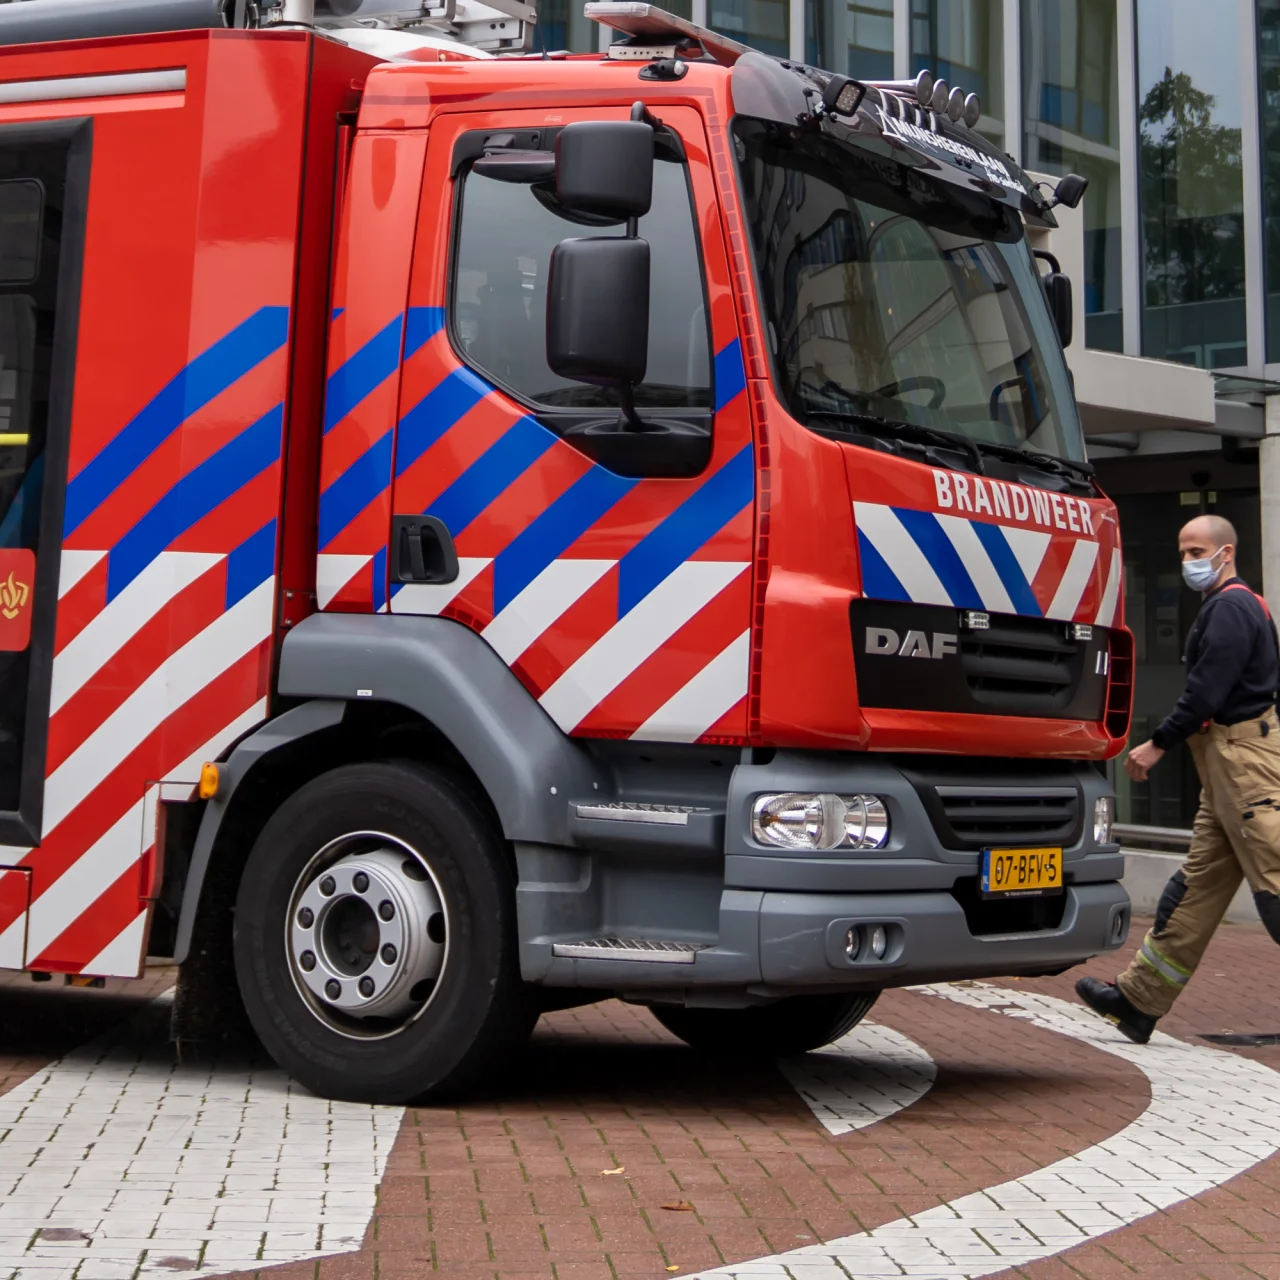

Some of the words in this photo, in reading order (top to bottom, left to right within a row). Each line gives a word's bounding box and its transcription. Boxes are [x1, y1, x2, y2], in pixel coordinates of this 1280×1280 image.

[932, 469, 1094, 535] BRANDWEER
[865, 627, 957, 659] DAF
[995, 854, 1056, 885] 07-BFV-5
